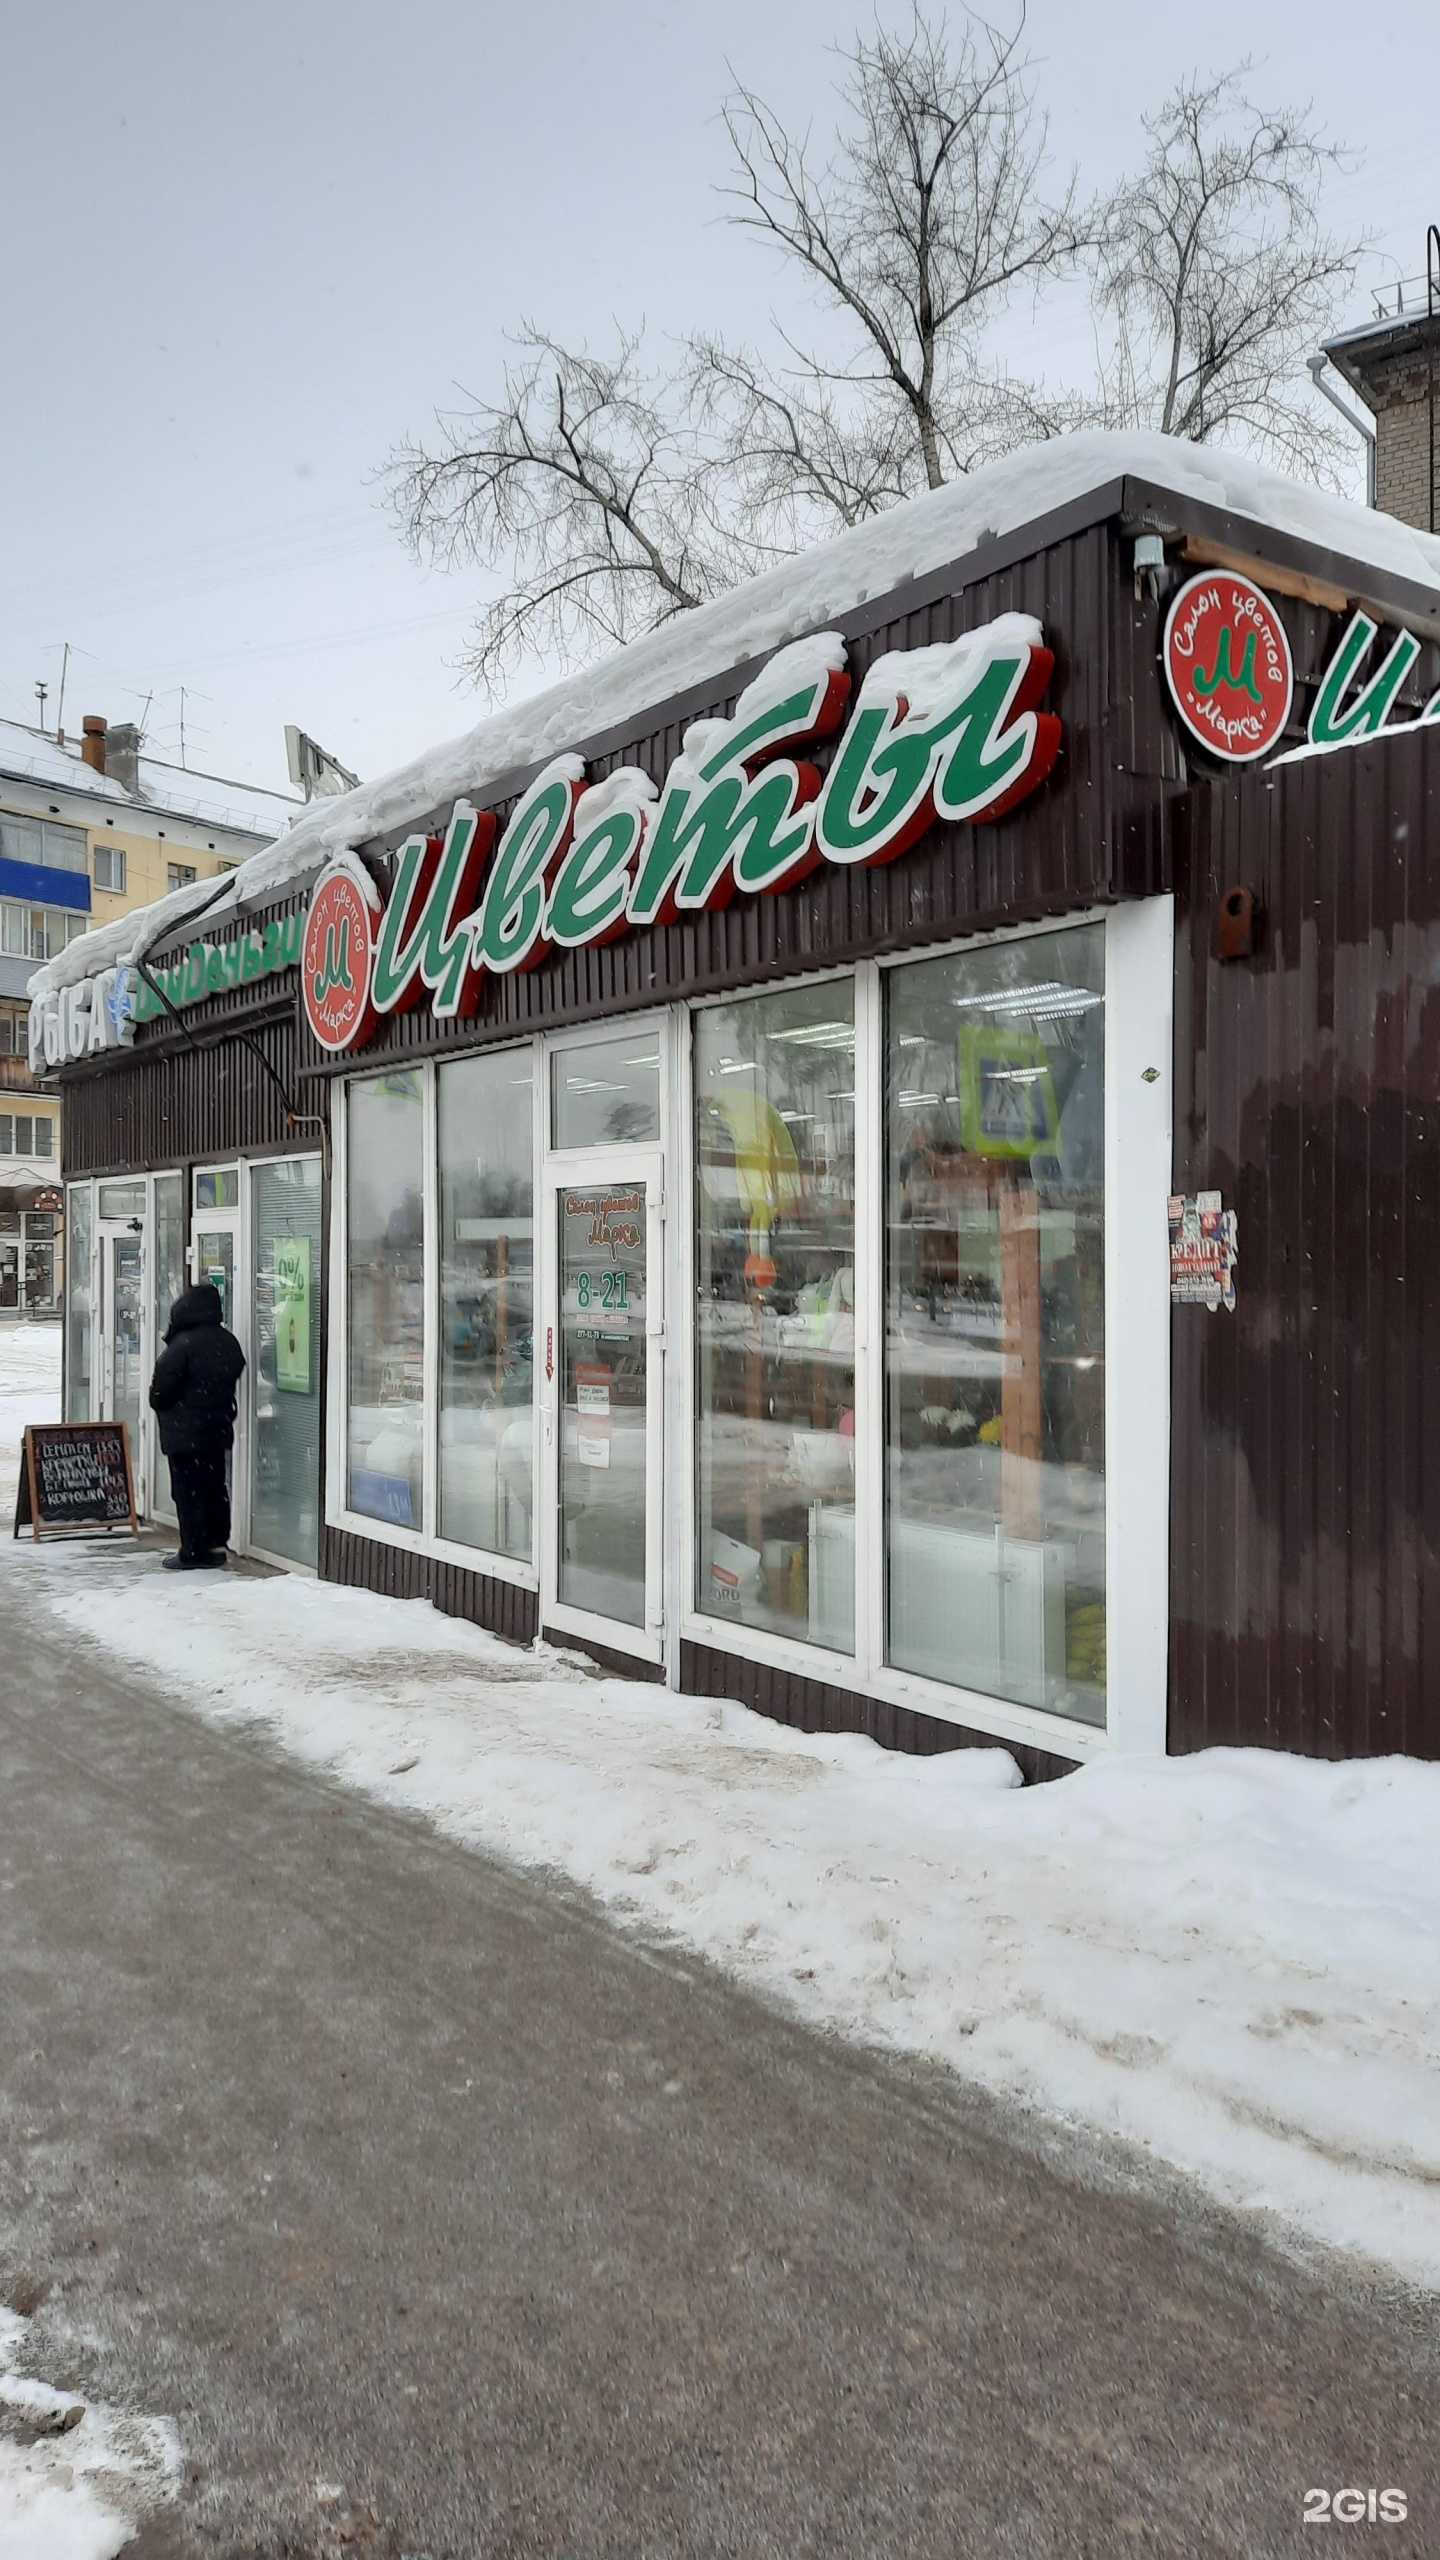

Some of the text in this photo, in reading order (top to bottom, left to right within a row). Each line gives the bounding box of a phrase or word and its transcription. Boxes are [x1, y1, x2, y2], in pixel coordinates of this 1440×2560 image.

[1174, 589, 1284, 684] Салон цветов
[372, 636, 1060, 1018] Цветы
[306, 883, 365, 974] Салон цветов
[586, 1215, 641, 1262] Марка
[576, 1271, 630, 1311] 8-21
